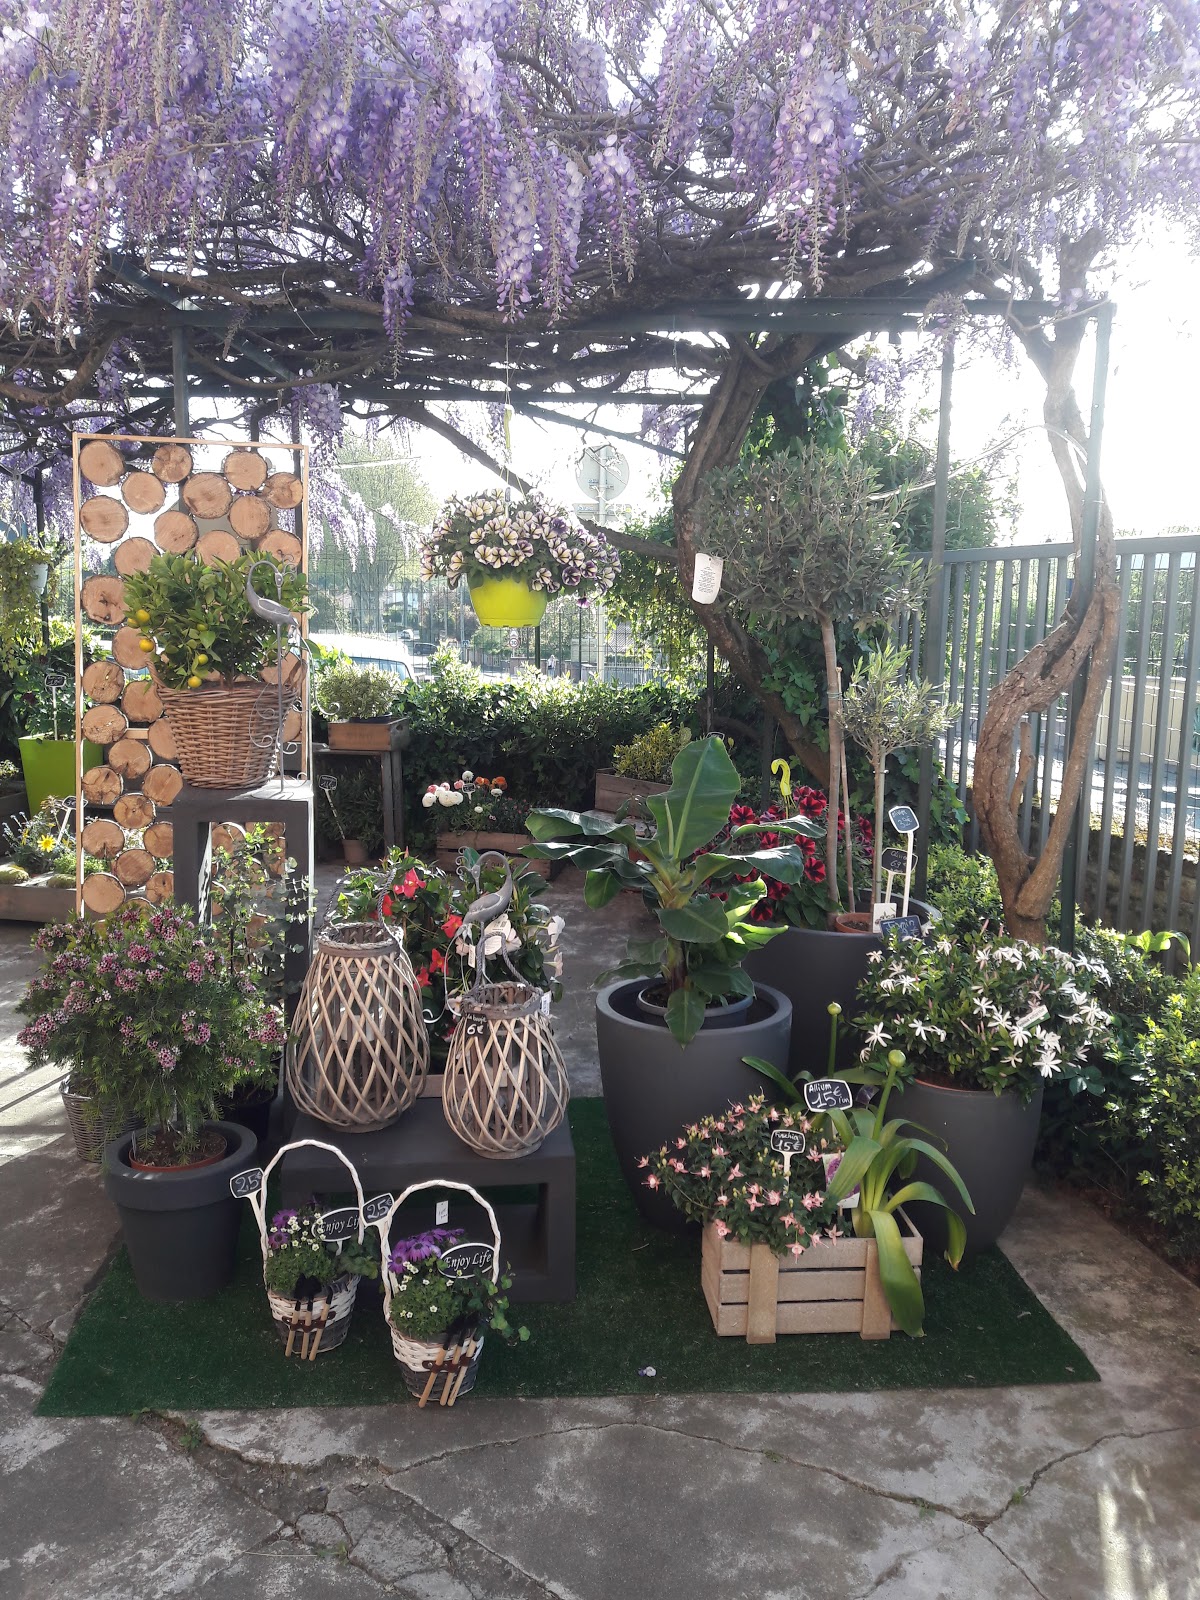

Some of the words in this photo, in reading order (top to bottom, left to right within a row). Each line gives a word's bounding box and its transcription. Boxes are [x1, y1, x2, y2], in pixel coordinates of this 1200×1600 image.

[808, 1083, 832, 1094] Allium
[775, 1139, 803, 1151] 15€
[443, 1254, 471, 1271] Enjoy
[471, 1249, 492, 1268] Life
